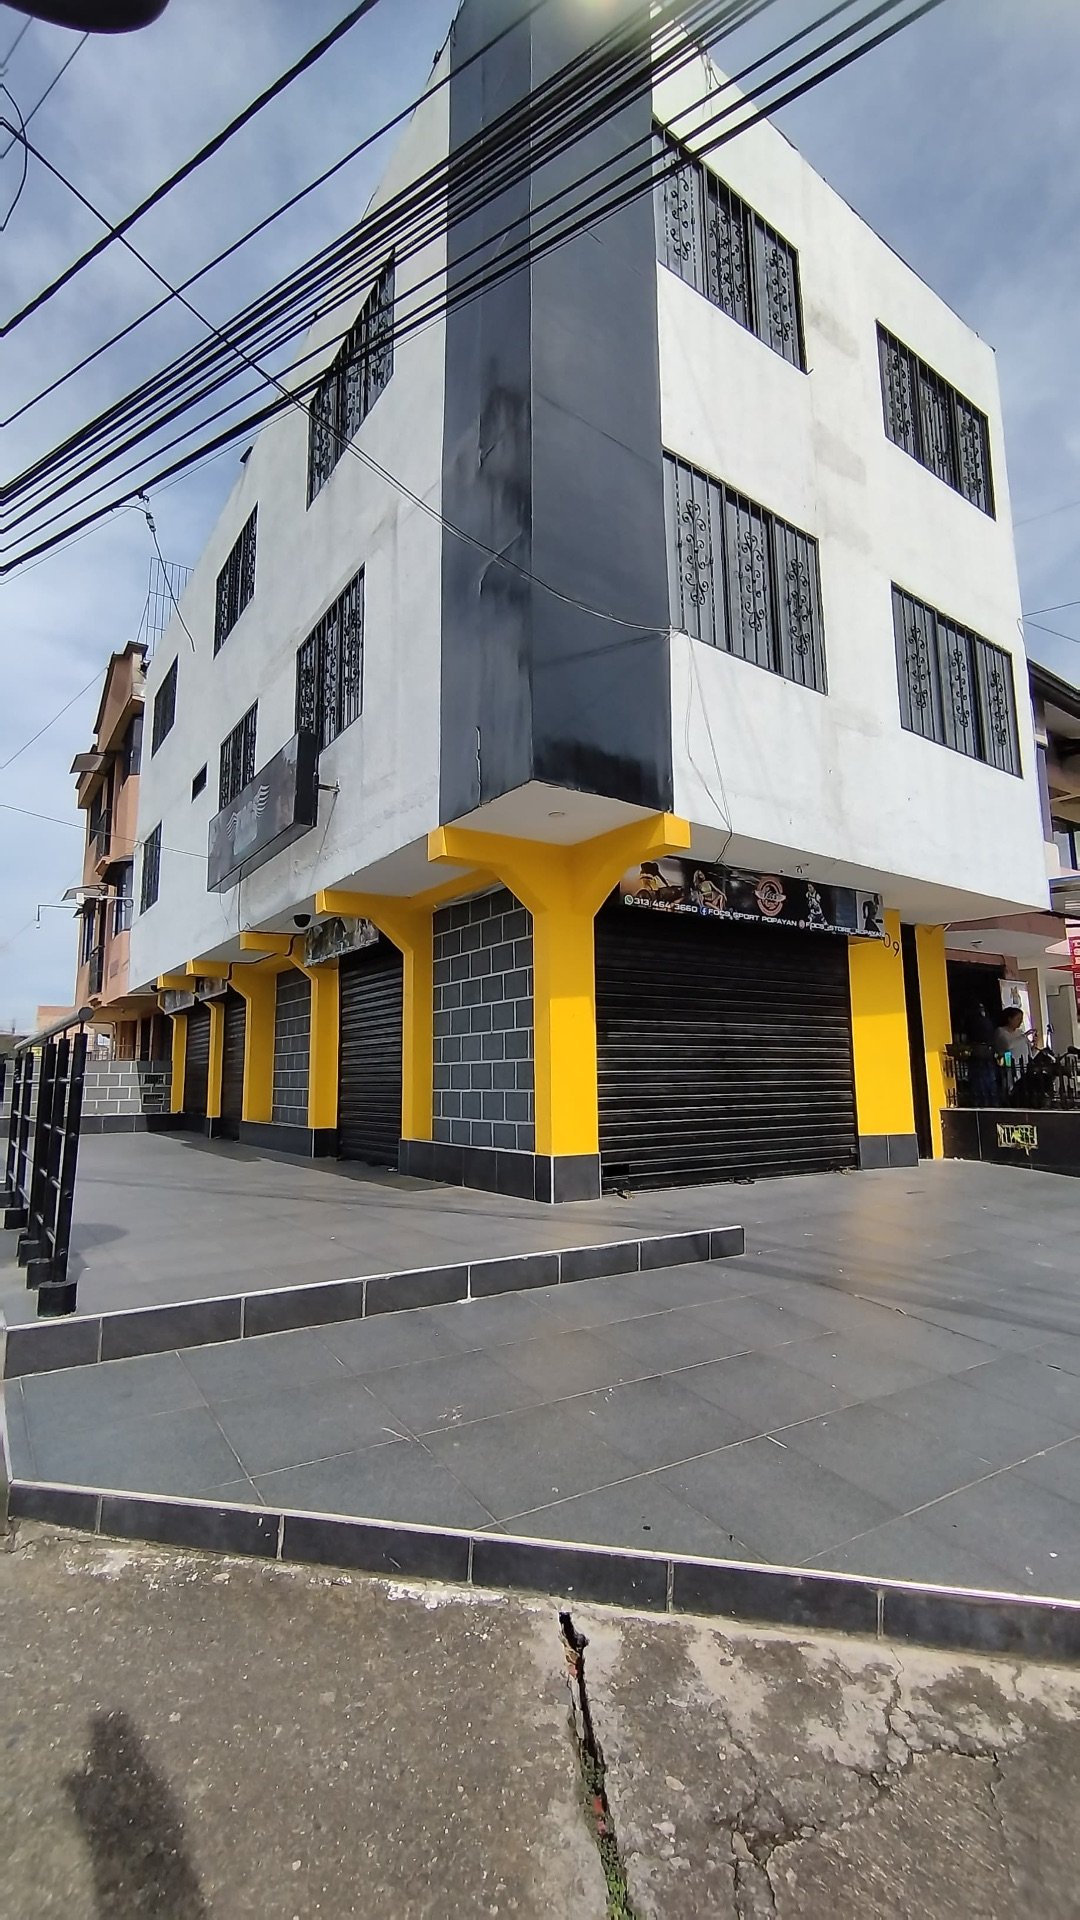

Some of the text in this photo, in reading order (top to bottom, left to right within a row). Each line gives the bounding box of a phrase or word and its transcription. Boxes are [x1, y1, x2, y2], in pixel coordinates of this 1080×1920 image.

[634, 897, 650, 906] 313
[652, 901, 671, 909] 464
[733, 912, 760, 921] SPORT
[761, 916, 798, 927] POPAYAN
